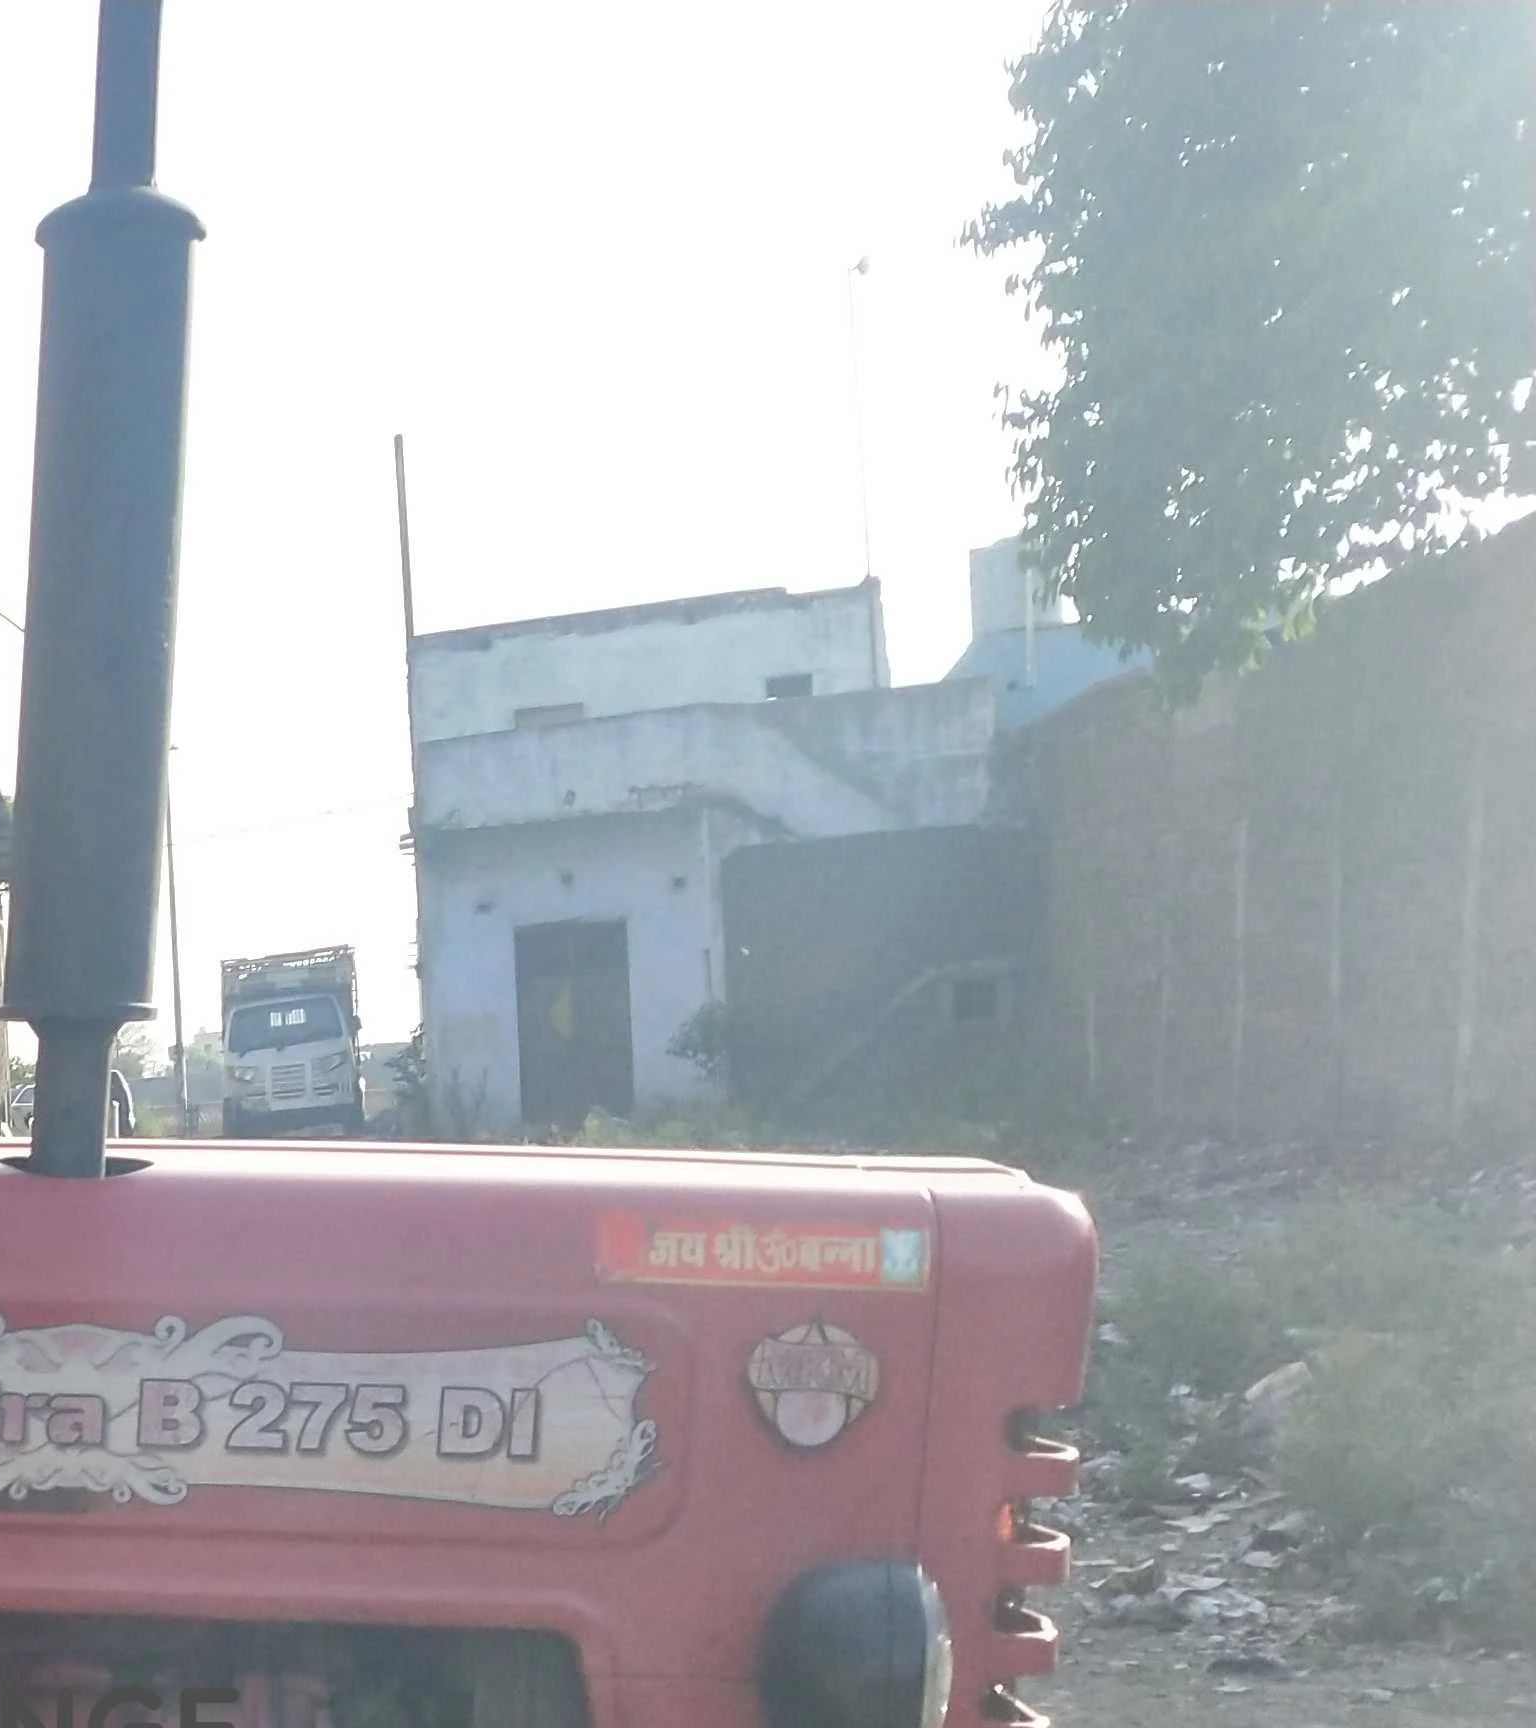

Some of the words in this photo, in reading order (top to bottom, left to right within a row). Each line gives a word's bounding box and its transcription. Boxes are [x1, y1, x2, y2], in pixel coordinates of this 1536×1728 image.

[648, 1230, 707, 1268] जय
[715, 1224, 757, 1271] श्री
[136, 1378, 205, 1451] B
[225, 1379, 410, 1458] 275
[436, 1386, 542, 1462] DI
